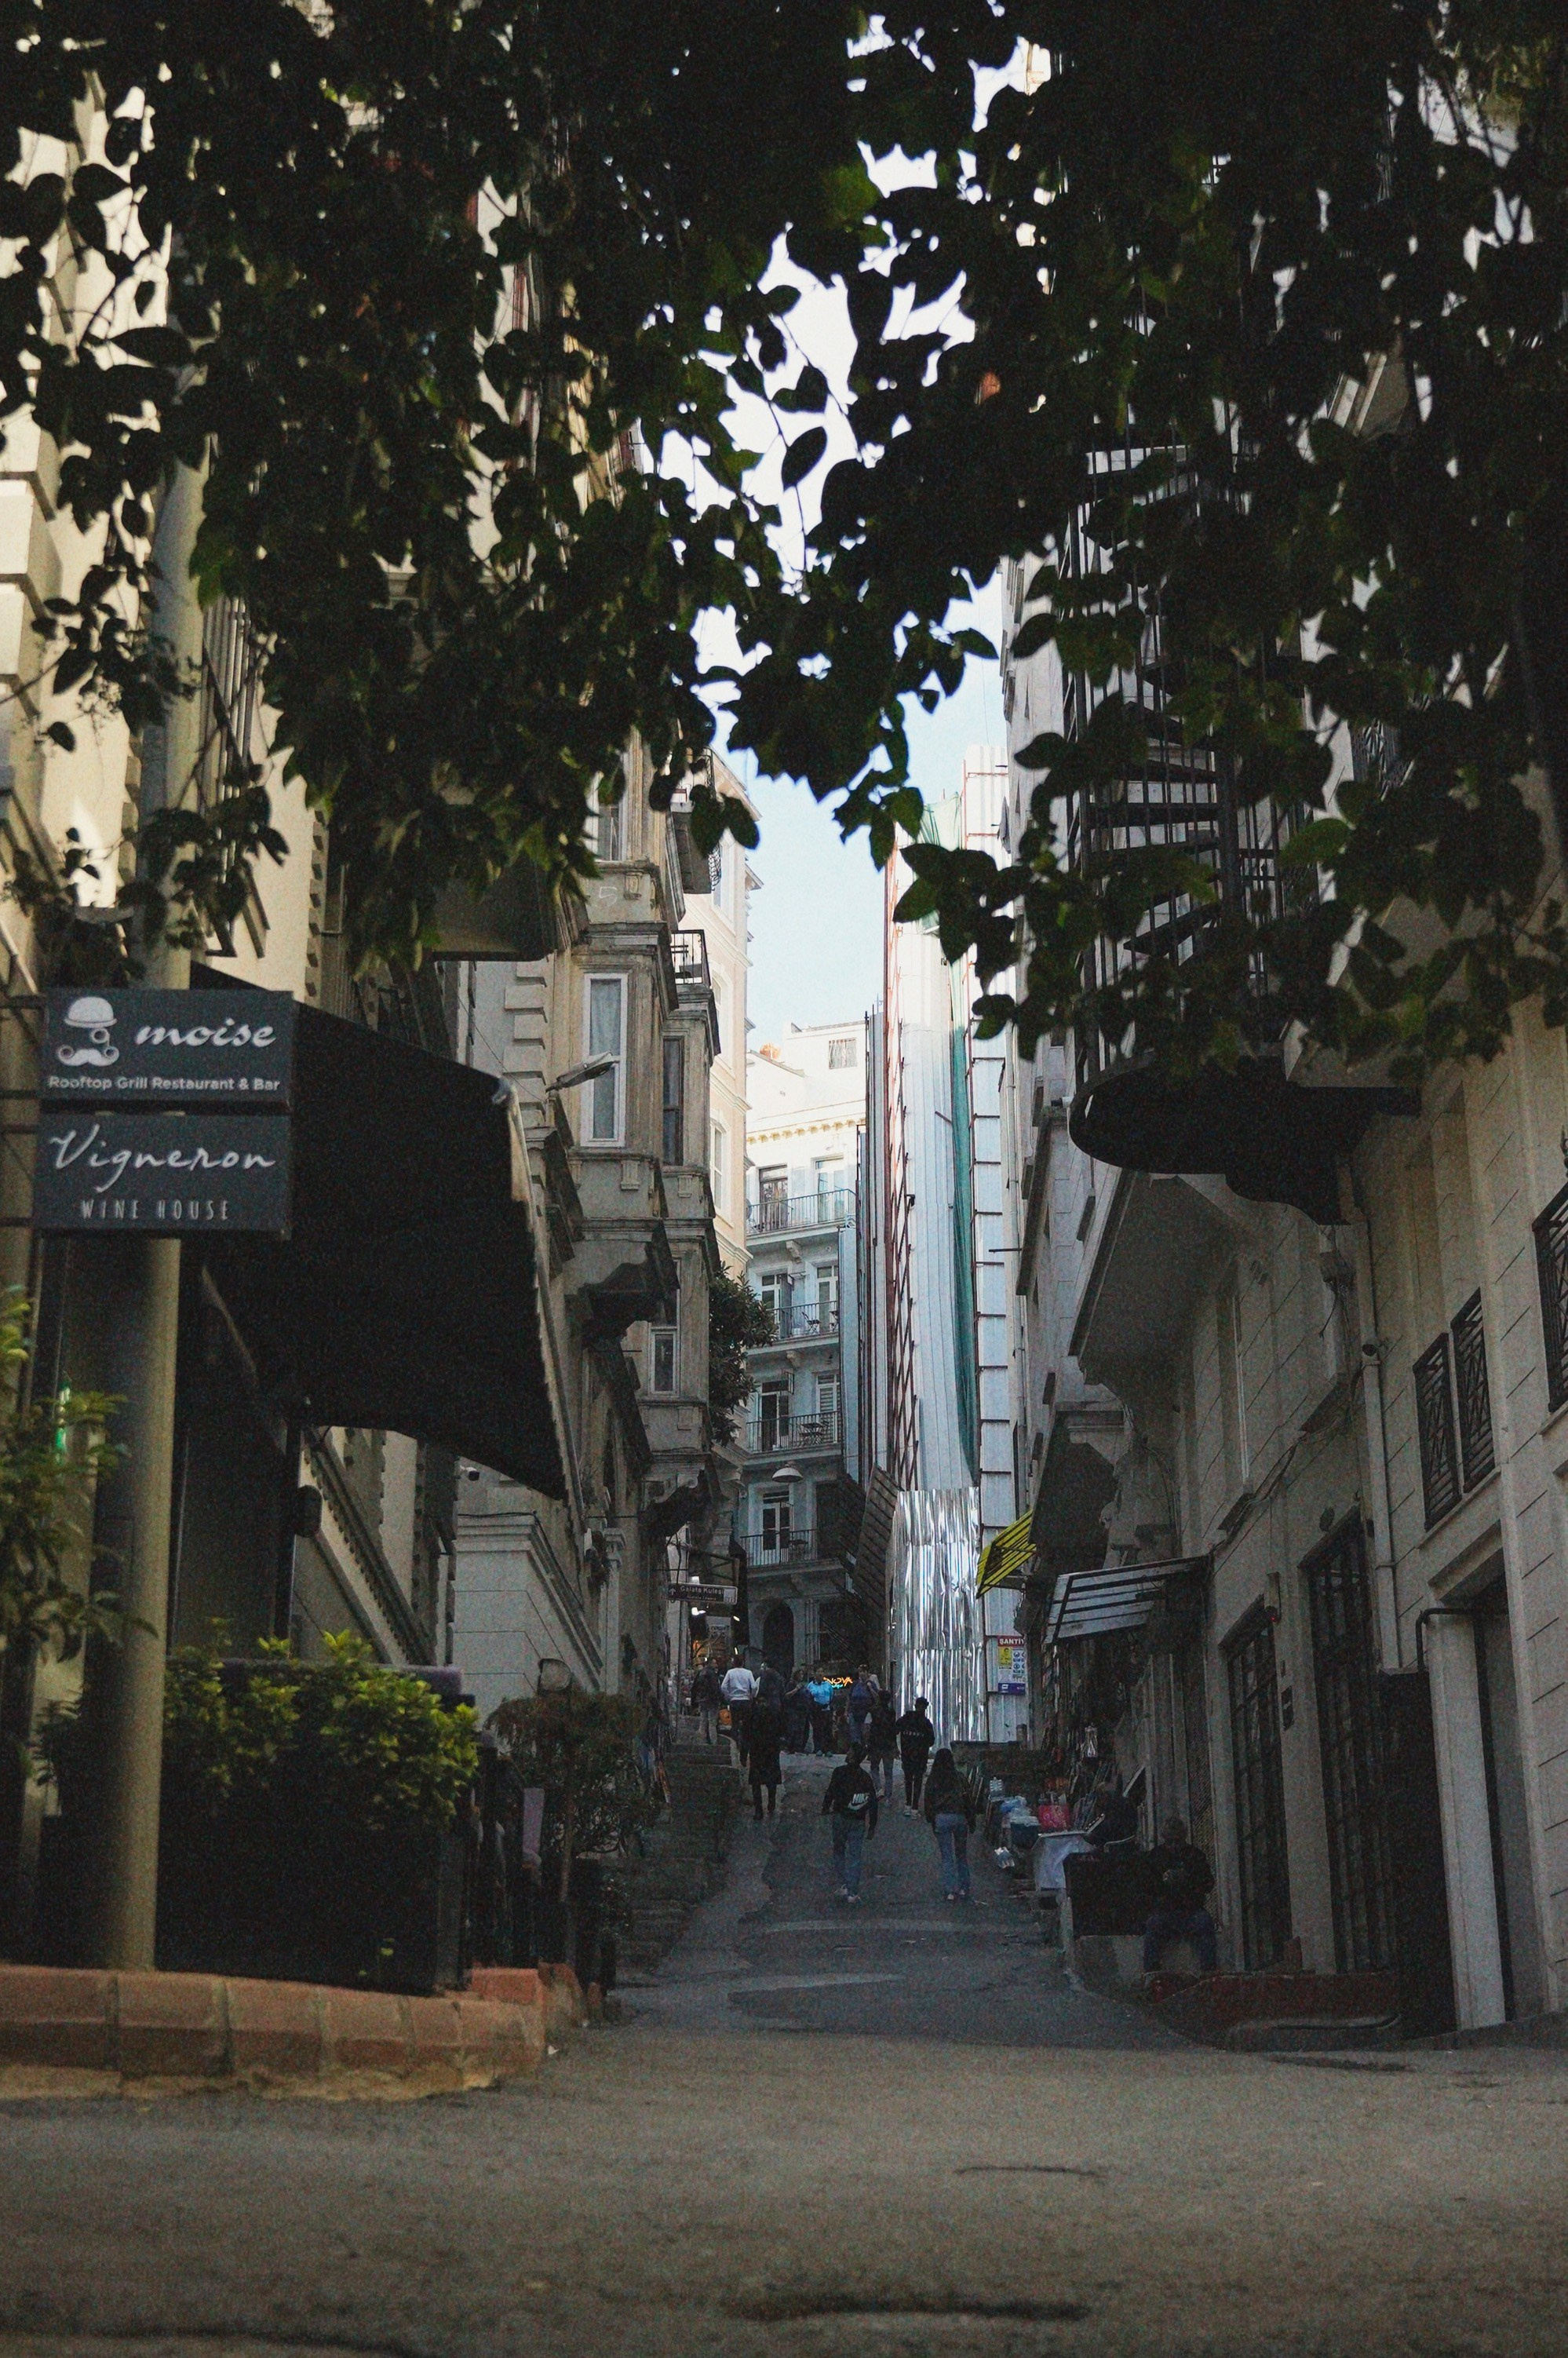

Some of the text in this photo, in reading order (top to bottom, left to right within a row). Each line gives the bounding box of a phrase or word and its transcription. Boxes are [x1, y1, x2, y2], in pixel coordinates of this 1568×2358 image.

[135, 1018, 277, 1048] moise
[49, 1075, 280, 1091] Rooftop Grill Restaurant & Bar
[49, 1124, 276, 1193] Vigneron
[81, 1199, 229, 1221] WINE HOUSE
